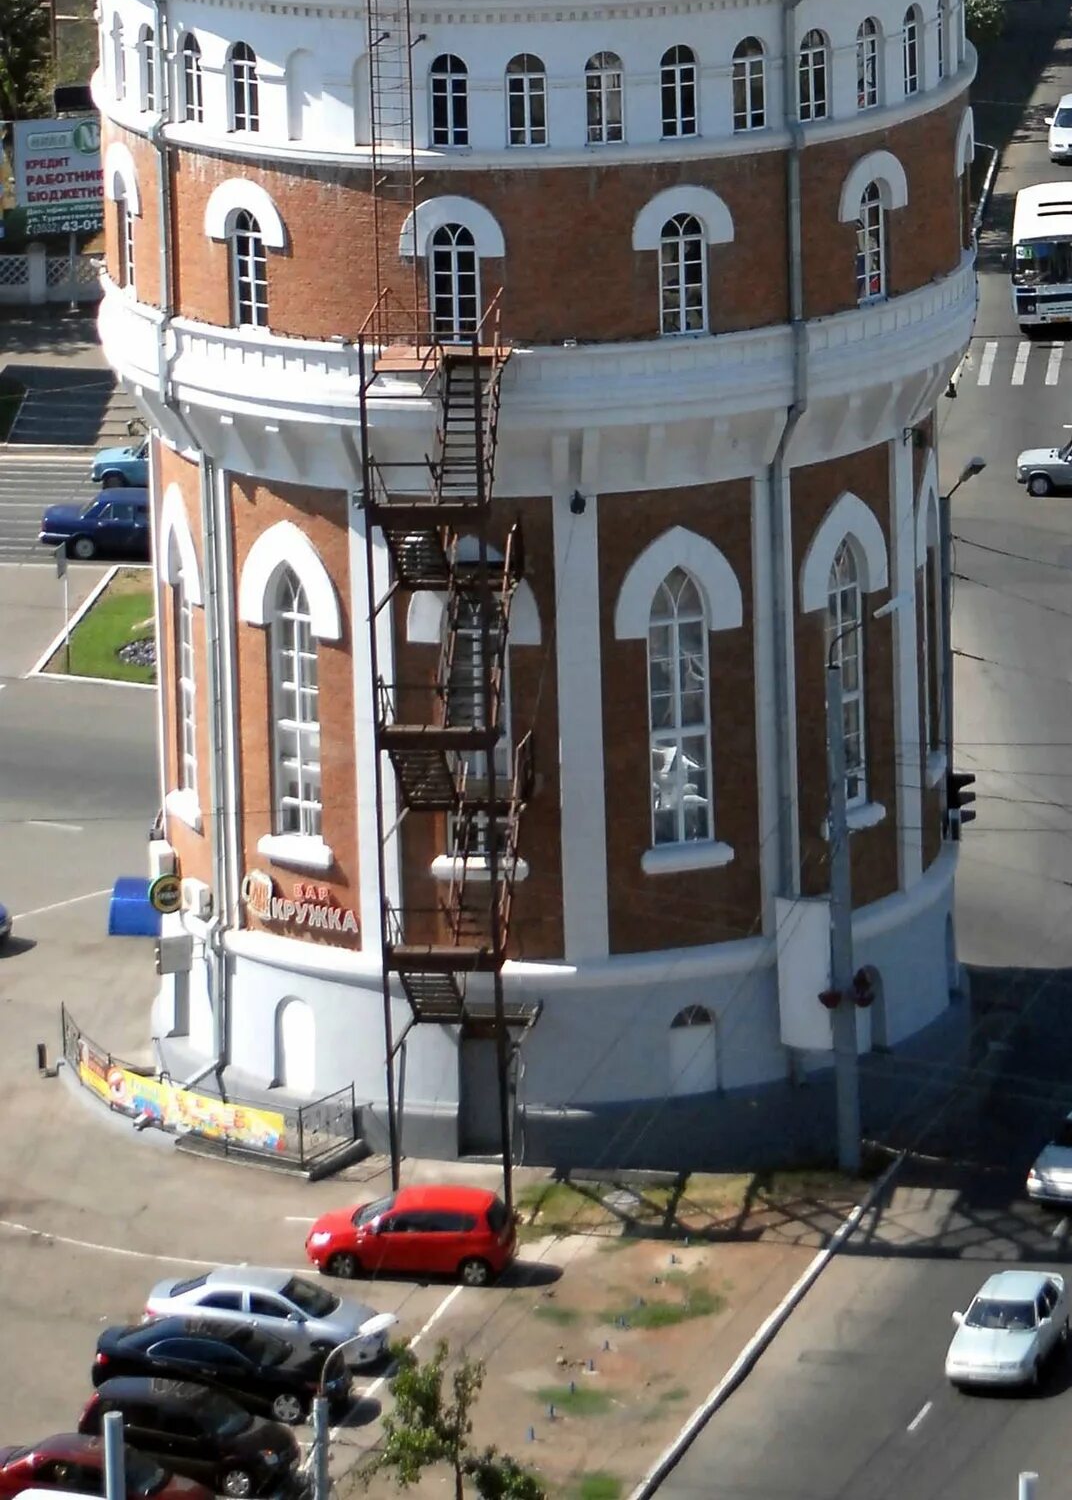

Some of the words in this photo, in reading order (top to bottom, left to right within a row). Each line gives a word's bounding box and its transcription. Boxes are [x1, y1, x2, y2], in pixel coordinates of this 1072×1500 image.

[25, 157, 70, 170] КРЕДИТ
[294, 884, 328, 901] БАР
[271, 897, 359, 933] КРУЖКА
